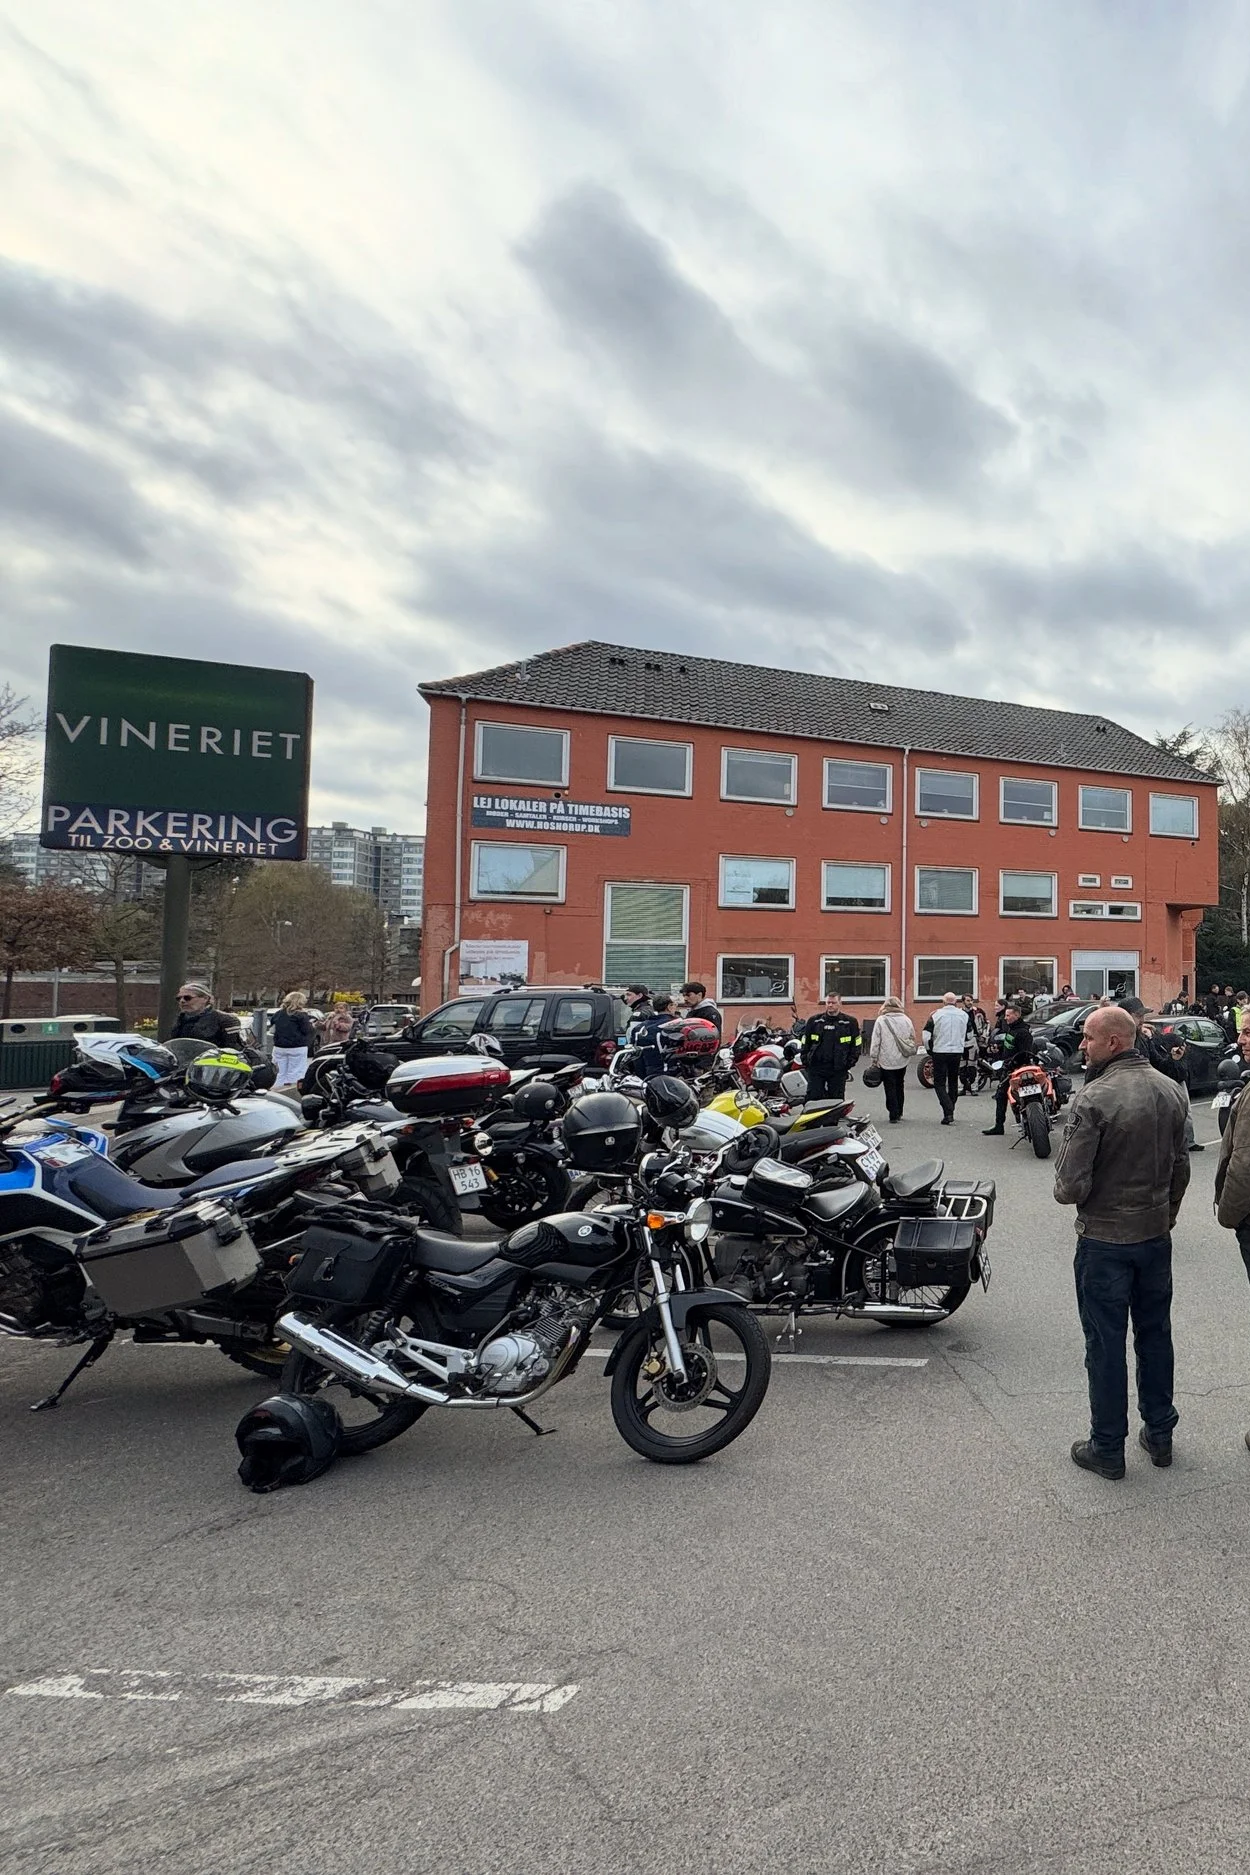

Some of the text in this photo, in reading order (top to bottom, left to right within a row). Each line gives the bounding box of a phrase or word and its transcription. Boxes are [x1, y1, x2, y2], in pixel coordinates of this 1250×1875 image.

[56, 712, 300, 760] VINERIET
[473, 796, 492, 809] LEJ
[494, 798, 547, 813] LOKALER
[567, 803, 631, 819] TIMEBASIS
[47, 805, 298, 843] PARKERING
[68, 833, 279, 855] TIL ZOO & VINERIET
[460, 1178, 480, 1191] 543
